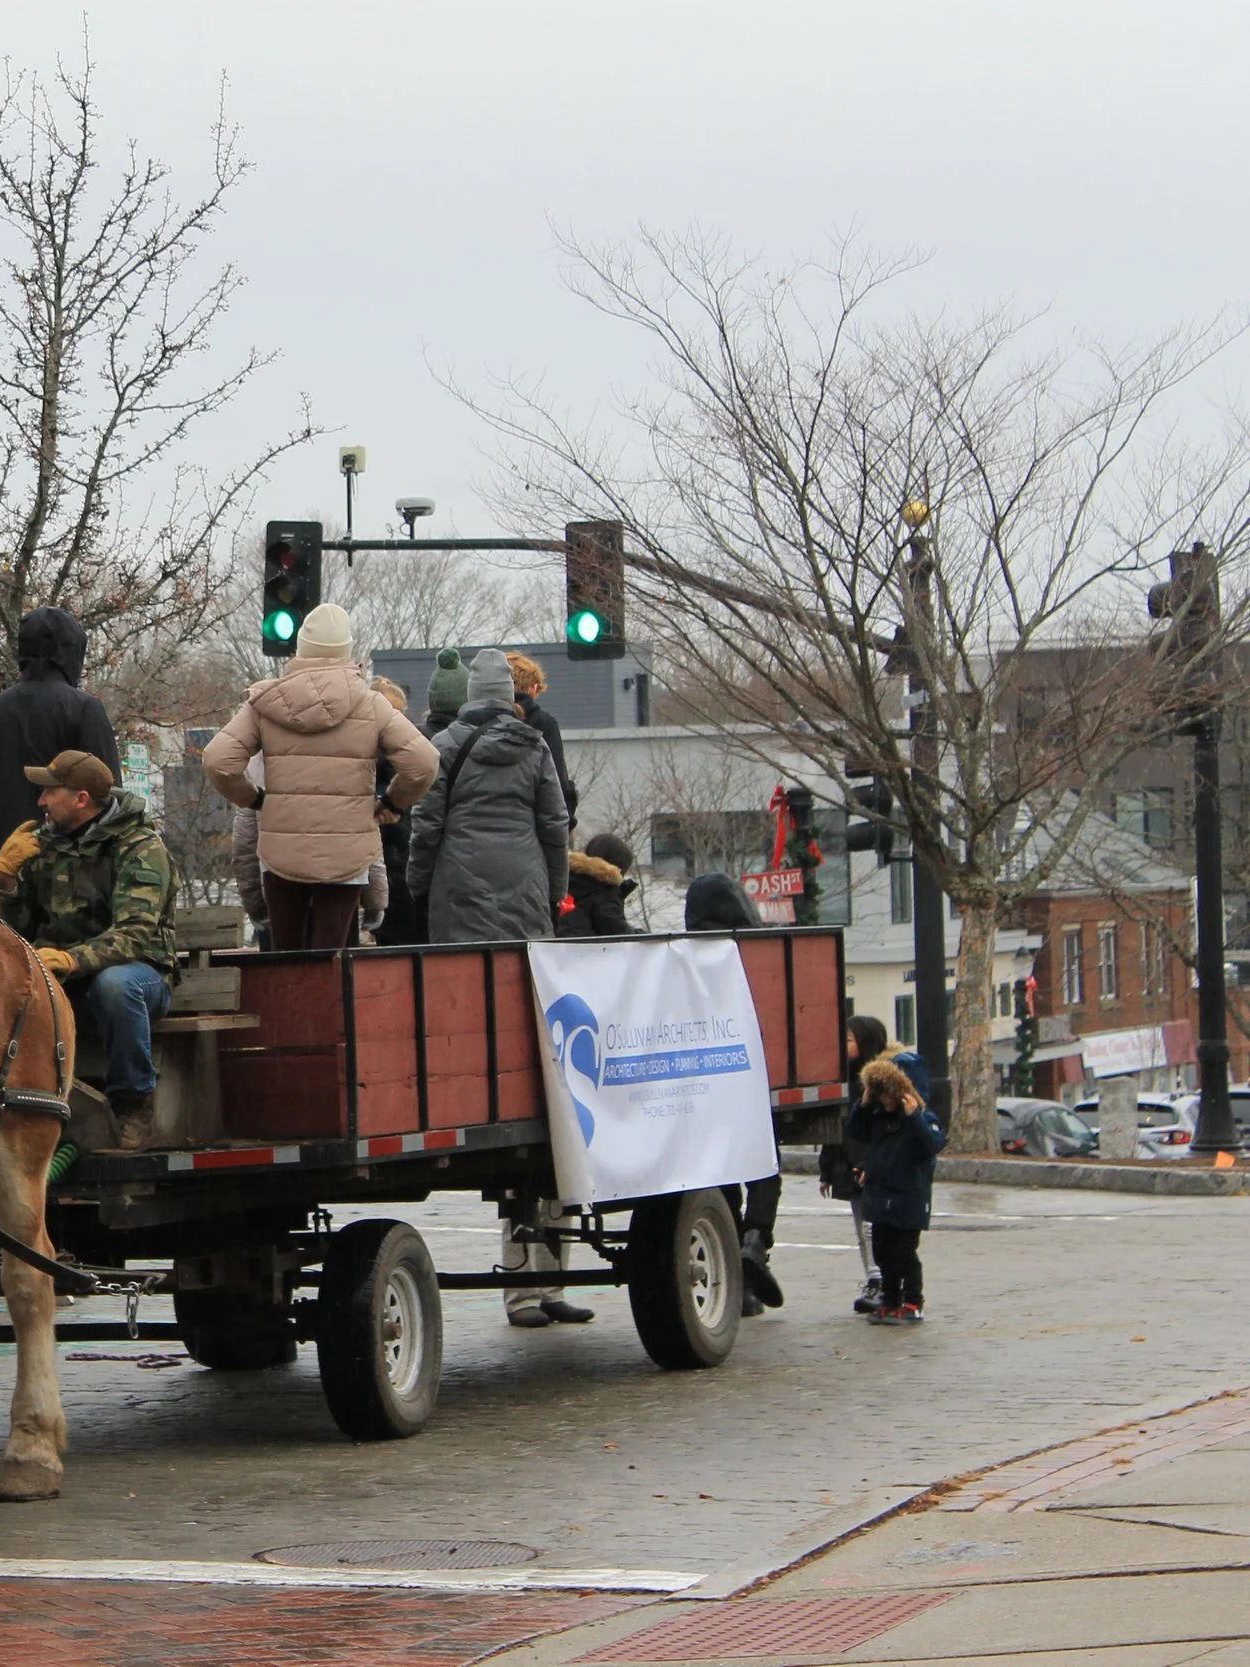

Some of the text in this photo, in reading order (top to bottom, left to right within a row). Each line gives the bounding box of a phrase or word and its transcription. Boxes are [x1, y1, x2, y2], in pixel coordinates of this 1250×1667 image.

[760, 873, 792, 894] ASH
[712, 1016, 741, 1040] INC.
[703, 1051, 747, 1069] INTERIORS
